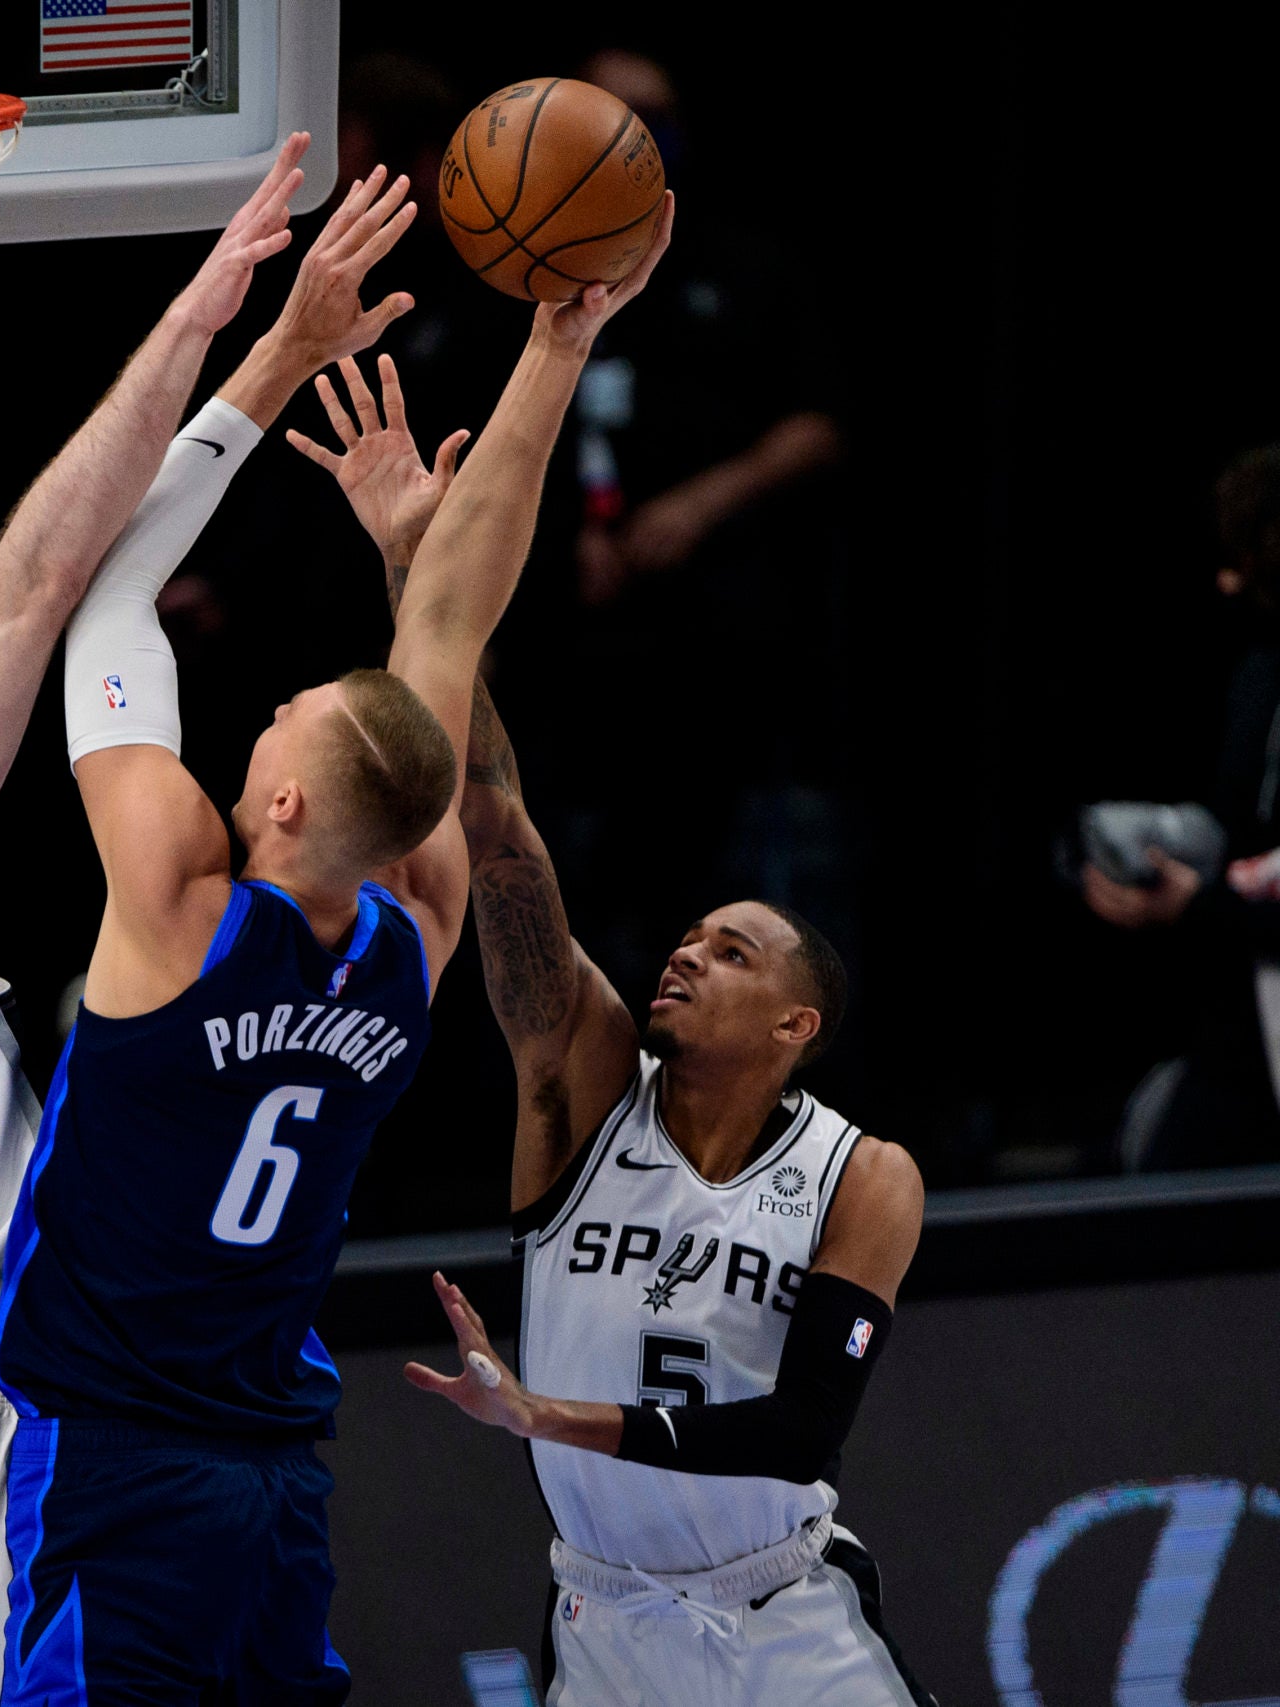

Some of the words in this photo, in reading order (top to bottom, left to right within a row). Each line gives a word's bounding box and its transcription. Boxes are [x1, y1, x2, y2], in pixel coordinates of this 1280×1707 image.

[204, 1003, 408, 1083] PORZINGIS
[209, 1085, 324, 1246] 6
[756, 1193, 814, 1218] Frost
[568, 1222, 811, 1317] SPURS
[637, 1329, 710, 1407] 5
